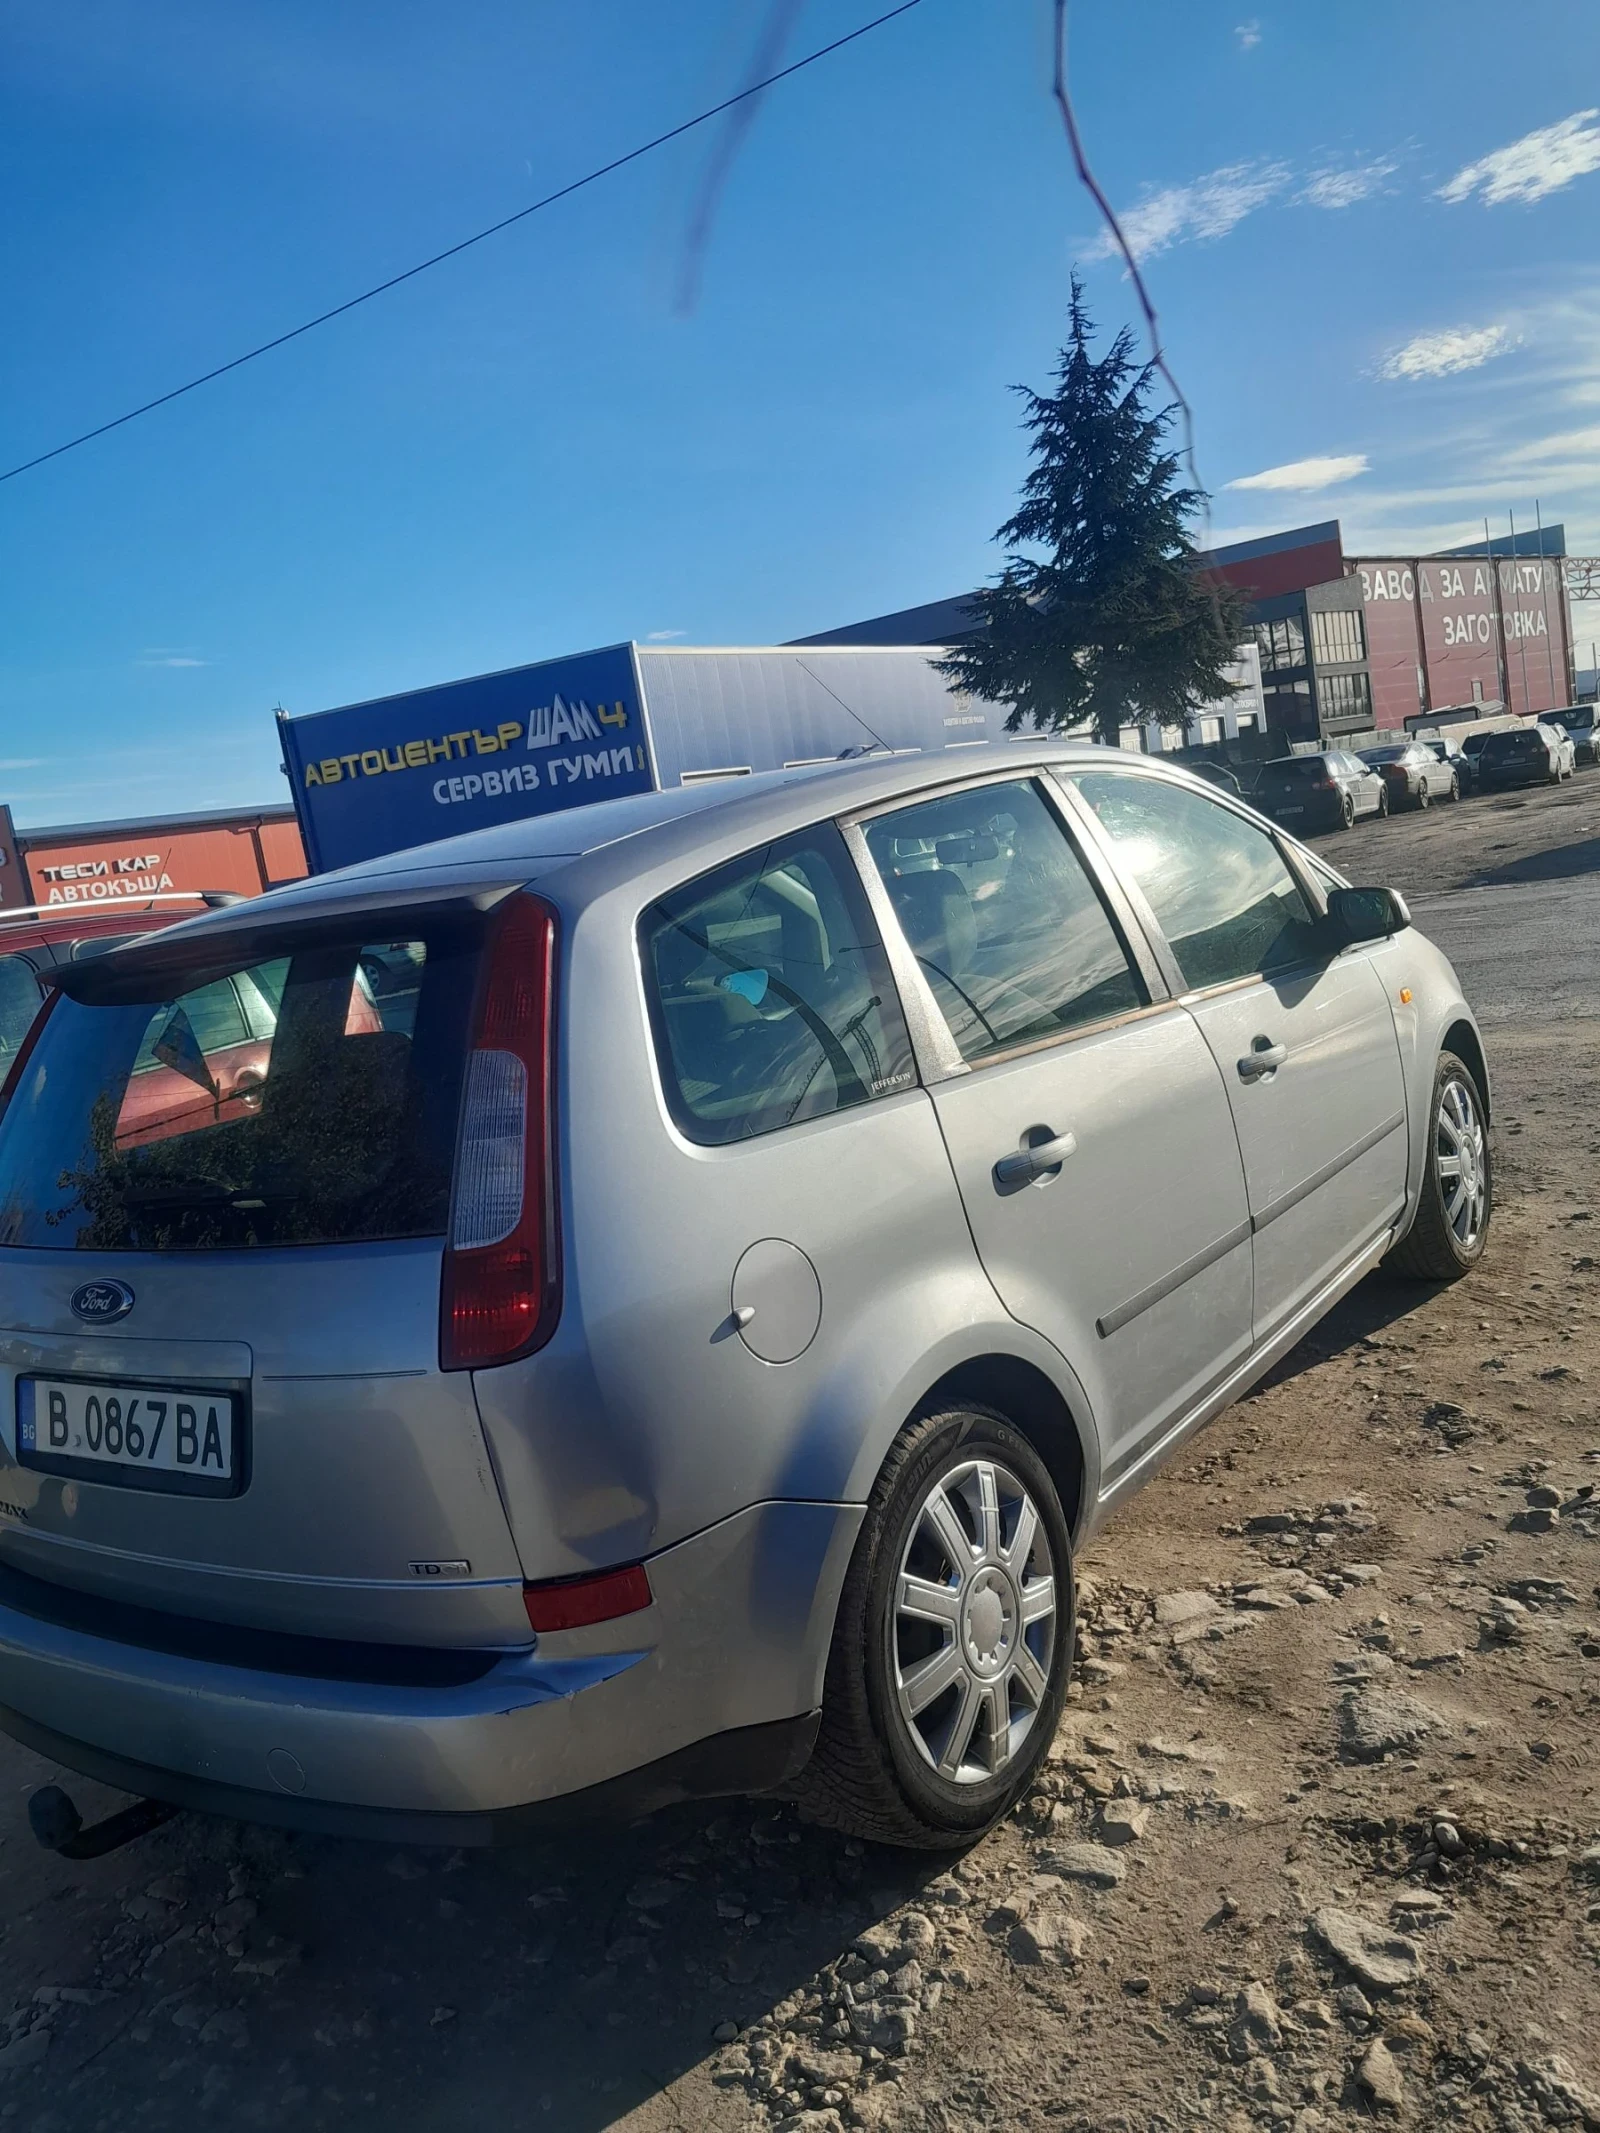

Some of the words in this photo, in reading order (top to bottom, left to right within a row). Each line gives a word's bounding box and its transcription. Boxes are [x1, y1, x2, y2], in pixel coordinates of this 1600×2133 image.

[1361, 570, 1434, 603] ЗАВОД
[1440, 568, 1466, 598] ЗА
[1443, 610, 1548, 645] ЗАГОТОВКА
[305, 721, 523, 788] АВТОЦЕНТЪР
[527, 693, 603, 750] ШАМ
[433, 764, 540, 804] СЕРВИЗ
[547, 746, 635, 786] ГУМИ
[43, 861, 109, 882] ТЕСИ
[116, 854, 161, 873] КАР
[49, 873, 174, 904] АВТОКЪЩА
[871, 1072, 911, 1094] JEFFERSON
[80, 1287, 111, 1312] Ford
[22, 1424, 35, 1440] BG
[86, 1395, 168, 1459] 0867
